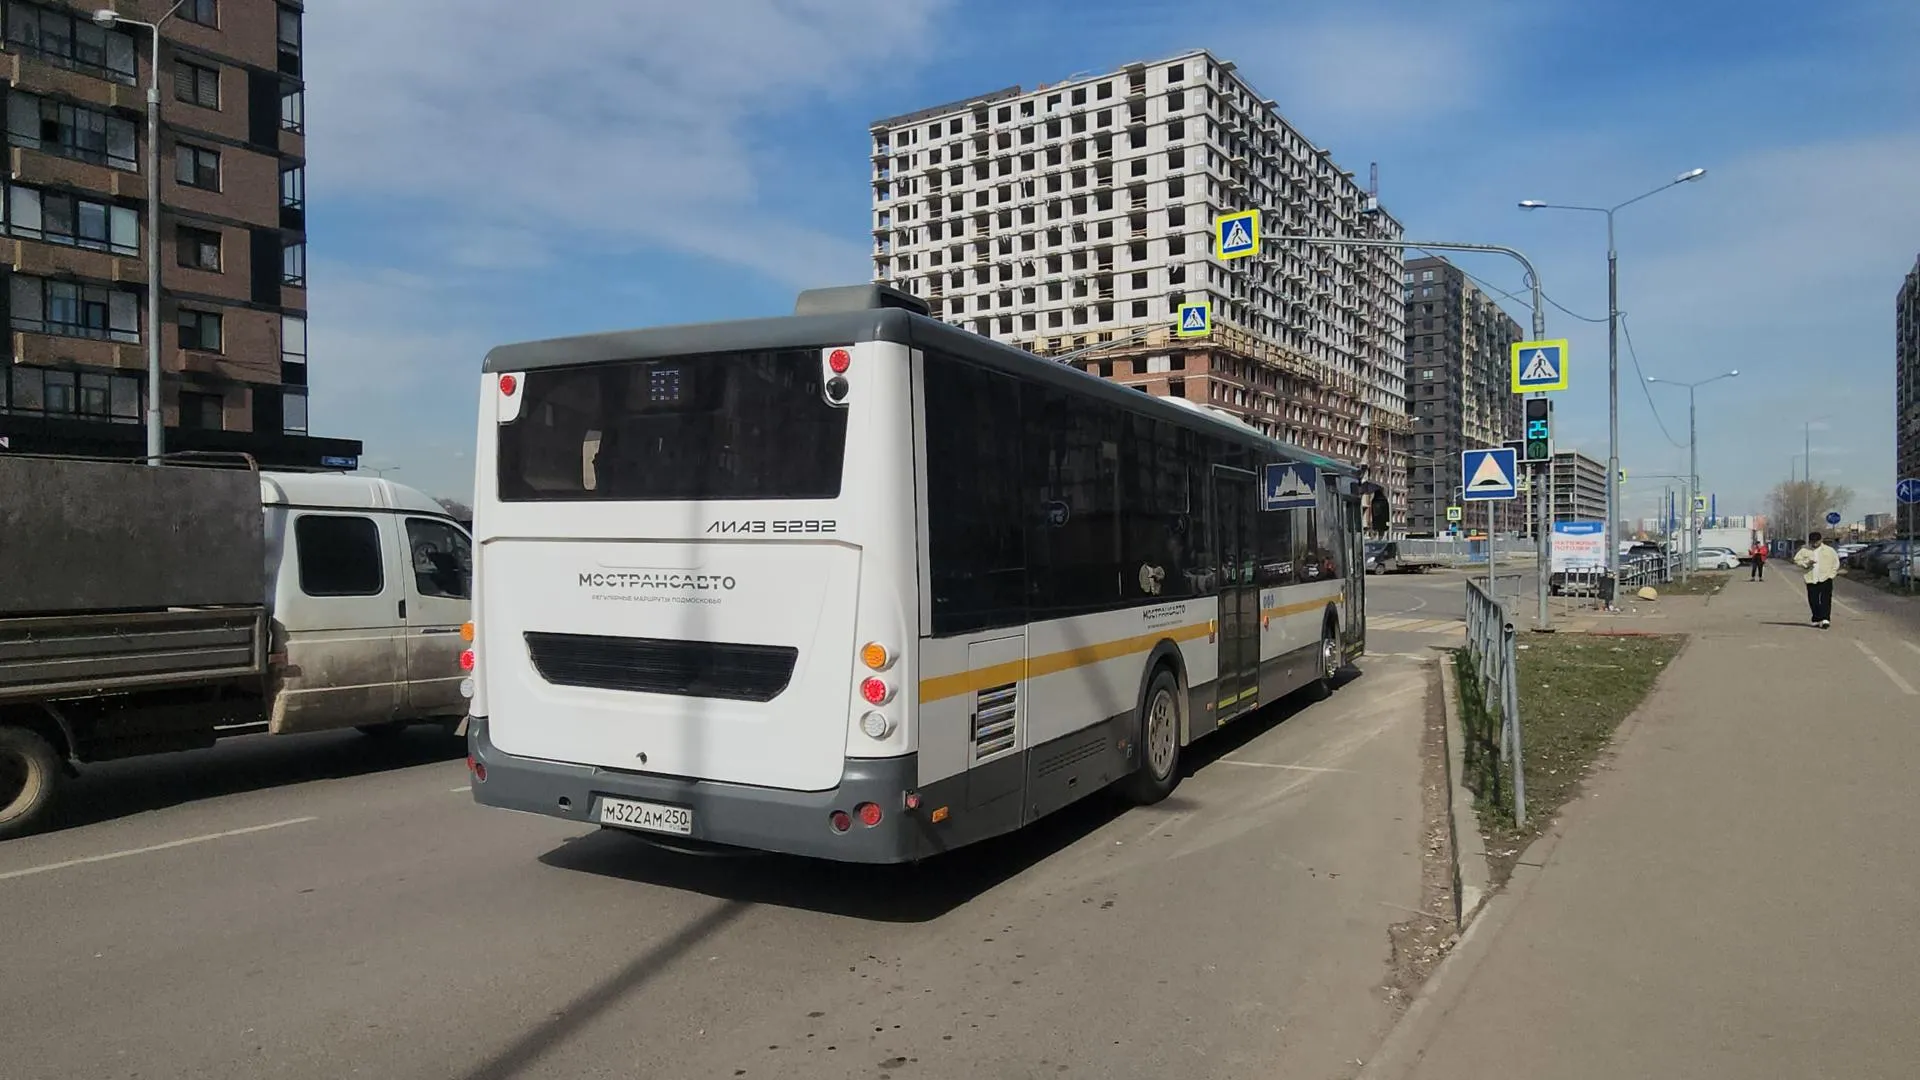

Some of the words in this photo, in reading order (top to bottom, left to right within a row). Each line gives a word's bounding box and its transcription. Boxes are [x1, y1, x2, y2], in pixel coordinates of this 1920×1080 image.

[1528, 420, 1548, 439] 25
[706, 521, 766, 533] ЛИАЗ
[772, 520, 837, 533] 5292
[578, 573, 736, 590] МОСТРАНСАВТО
[664, 809, 688, 825] 250
